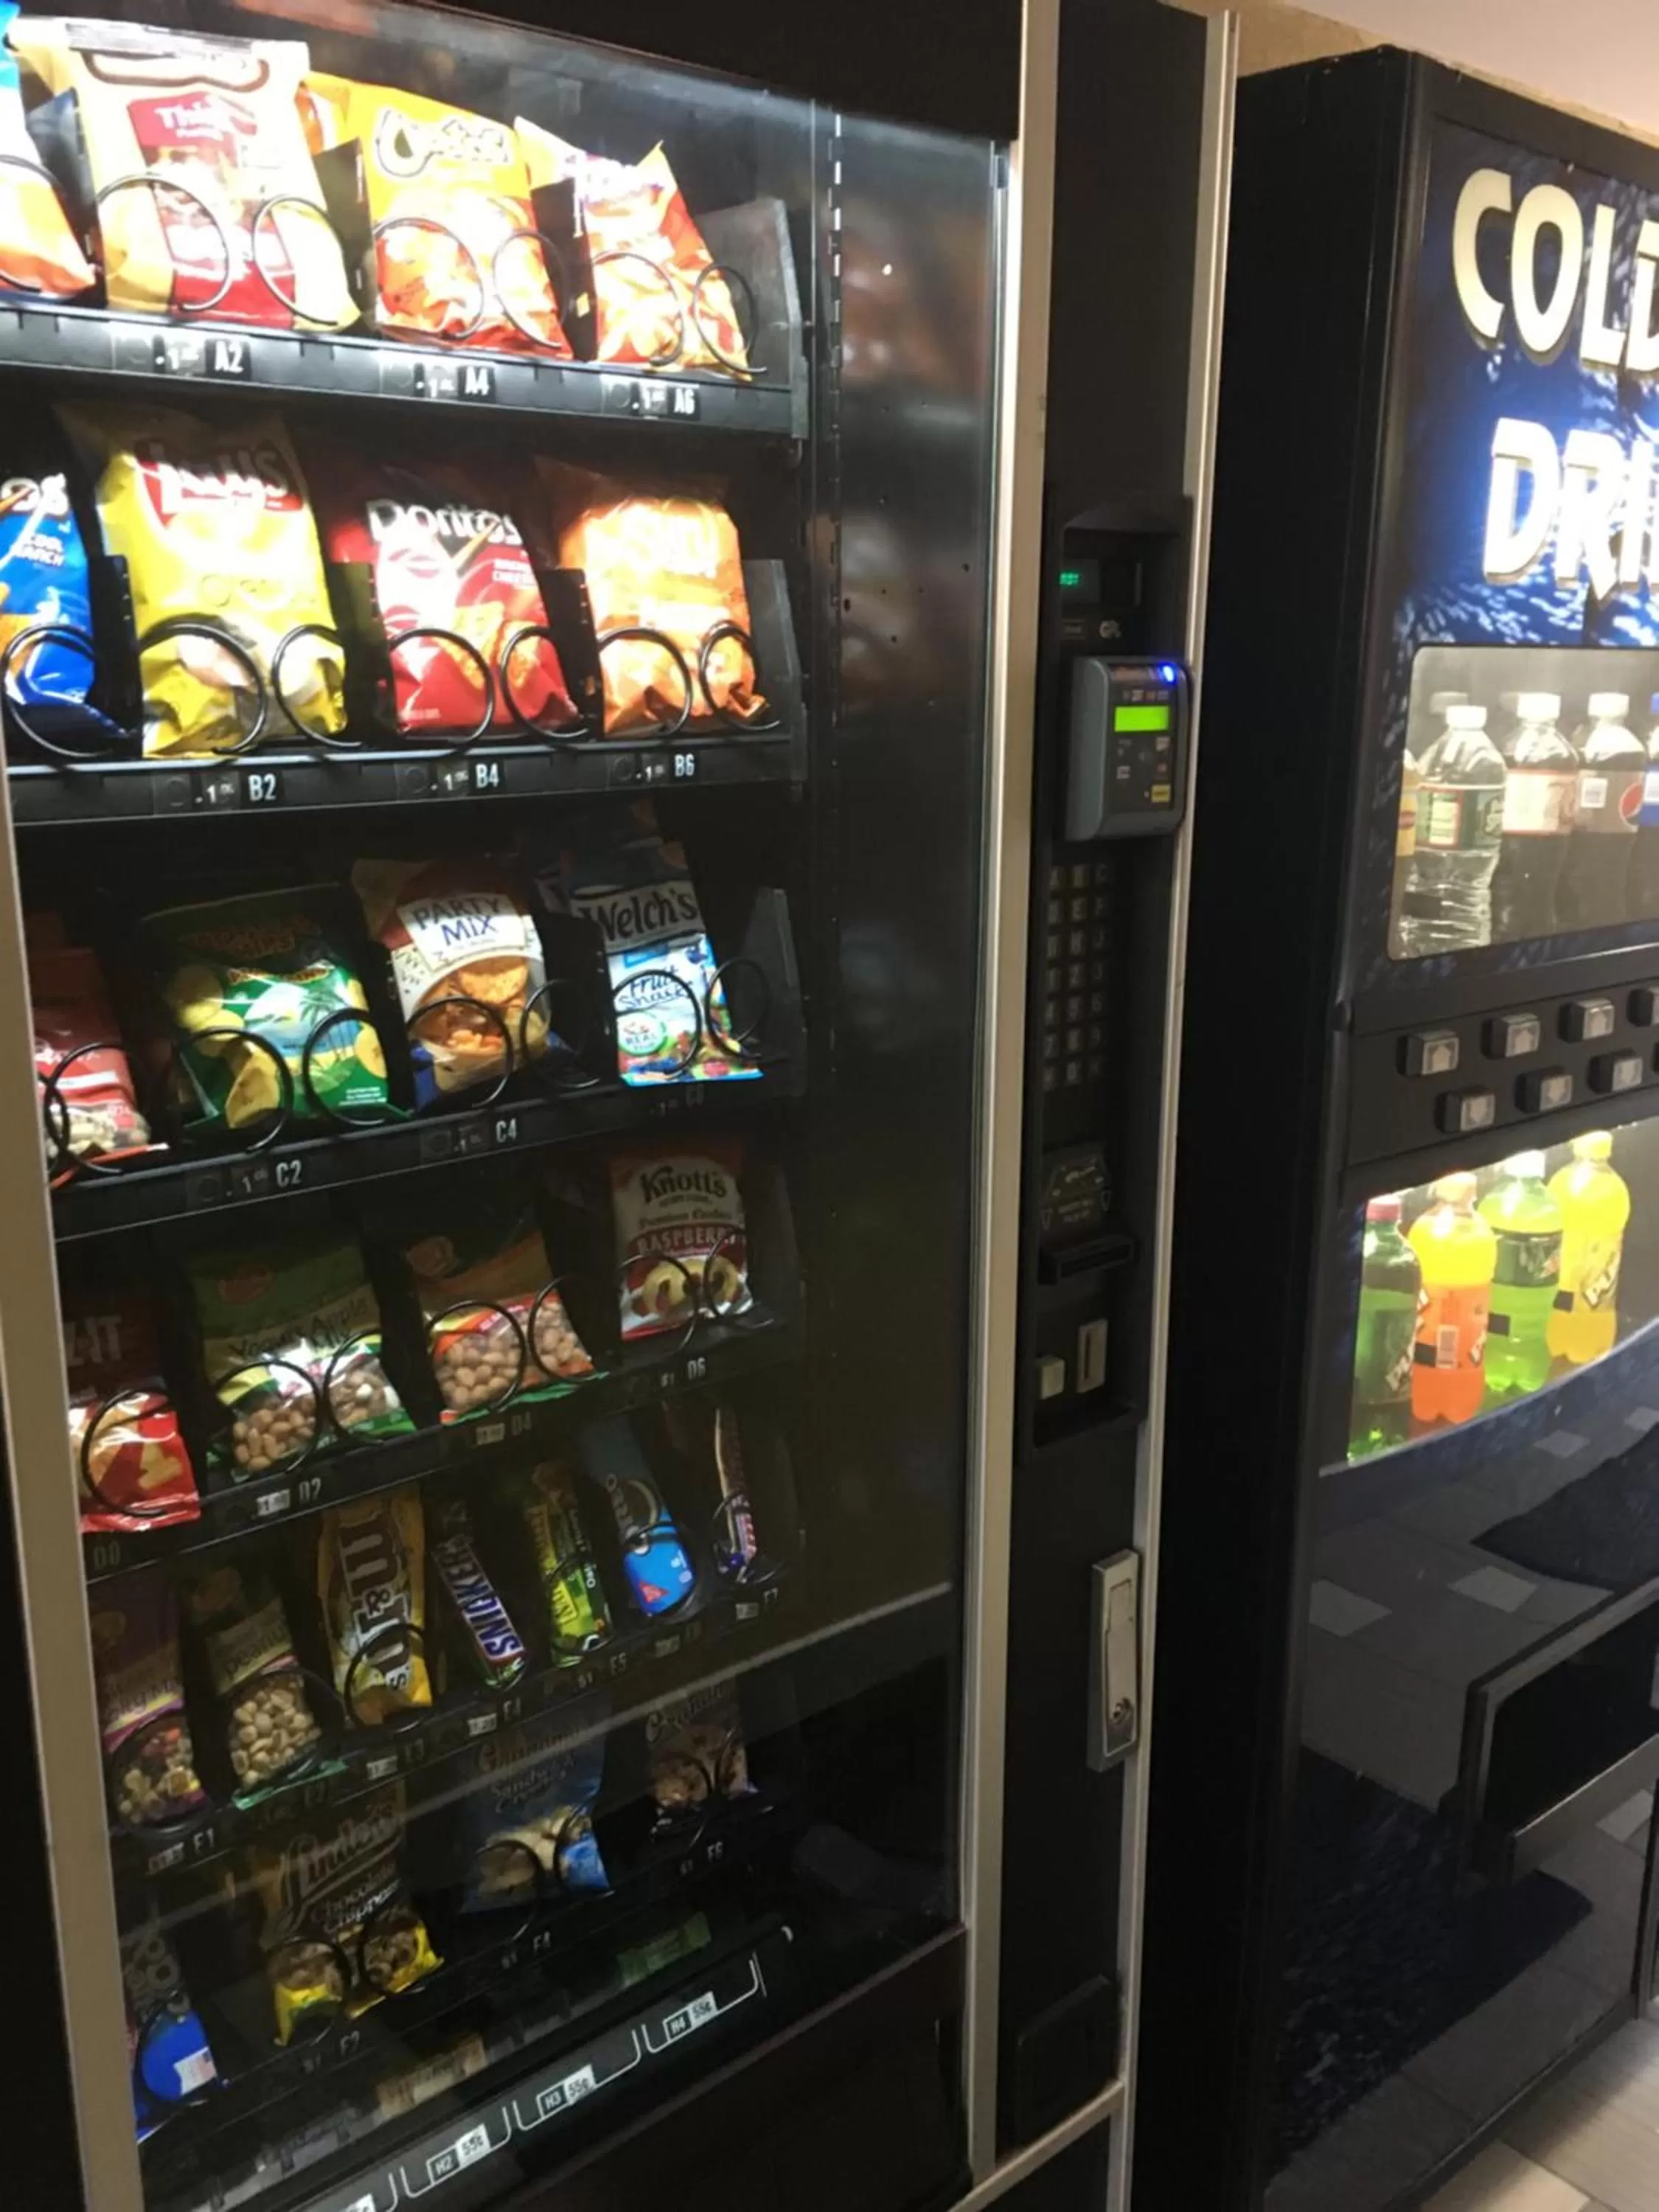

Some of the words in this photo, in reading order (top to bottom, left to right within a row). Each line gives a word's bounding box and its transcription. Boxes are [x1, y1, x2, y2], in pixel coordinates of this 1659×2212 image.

[215, 340, 244, 375] A2
[465, 366, 490, 397] A4
[674, 387, 695, 415] A6
[366, 498, 523, 546] Doritos
[1482, 417, 1659, 599] DRI
[475, 762, 500, 789] B4
[675, 753, 695, 778] B6
[248, 773, 277, 802] B2
[413, 894, 500, 931] PARTY
[441, 914, 499, 946] MIX
[495, 1118, 518, 1144] C4
[276, 1158, 302, 1188] C2
[639, 1165, 727, 1205] Knott's
[637, 1225, 746, 1253] RASPBERR
[668, 2014, 689, 2034] H4
[544, 2092, 563, 2112] H3
